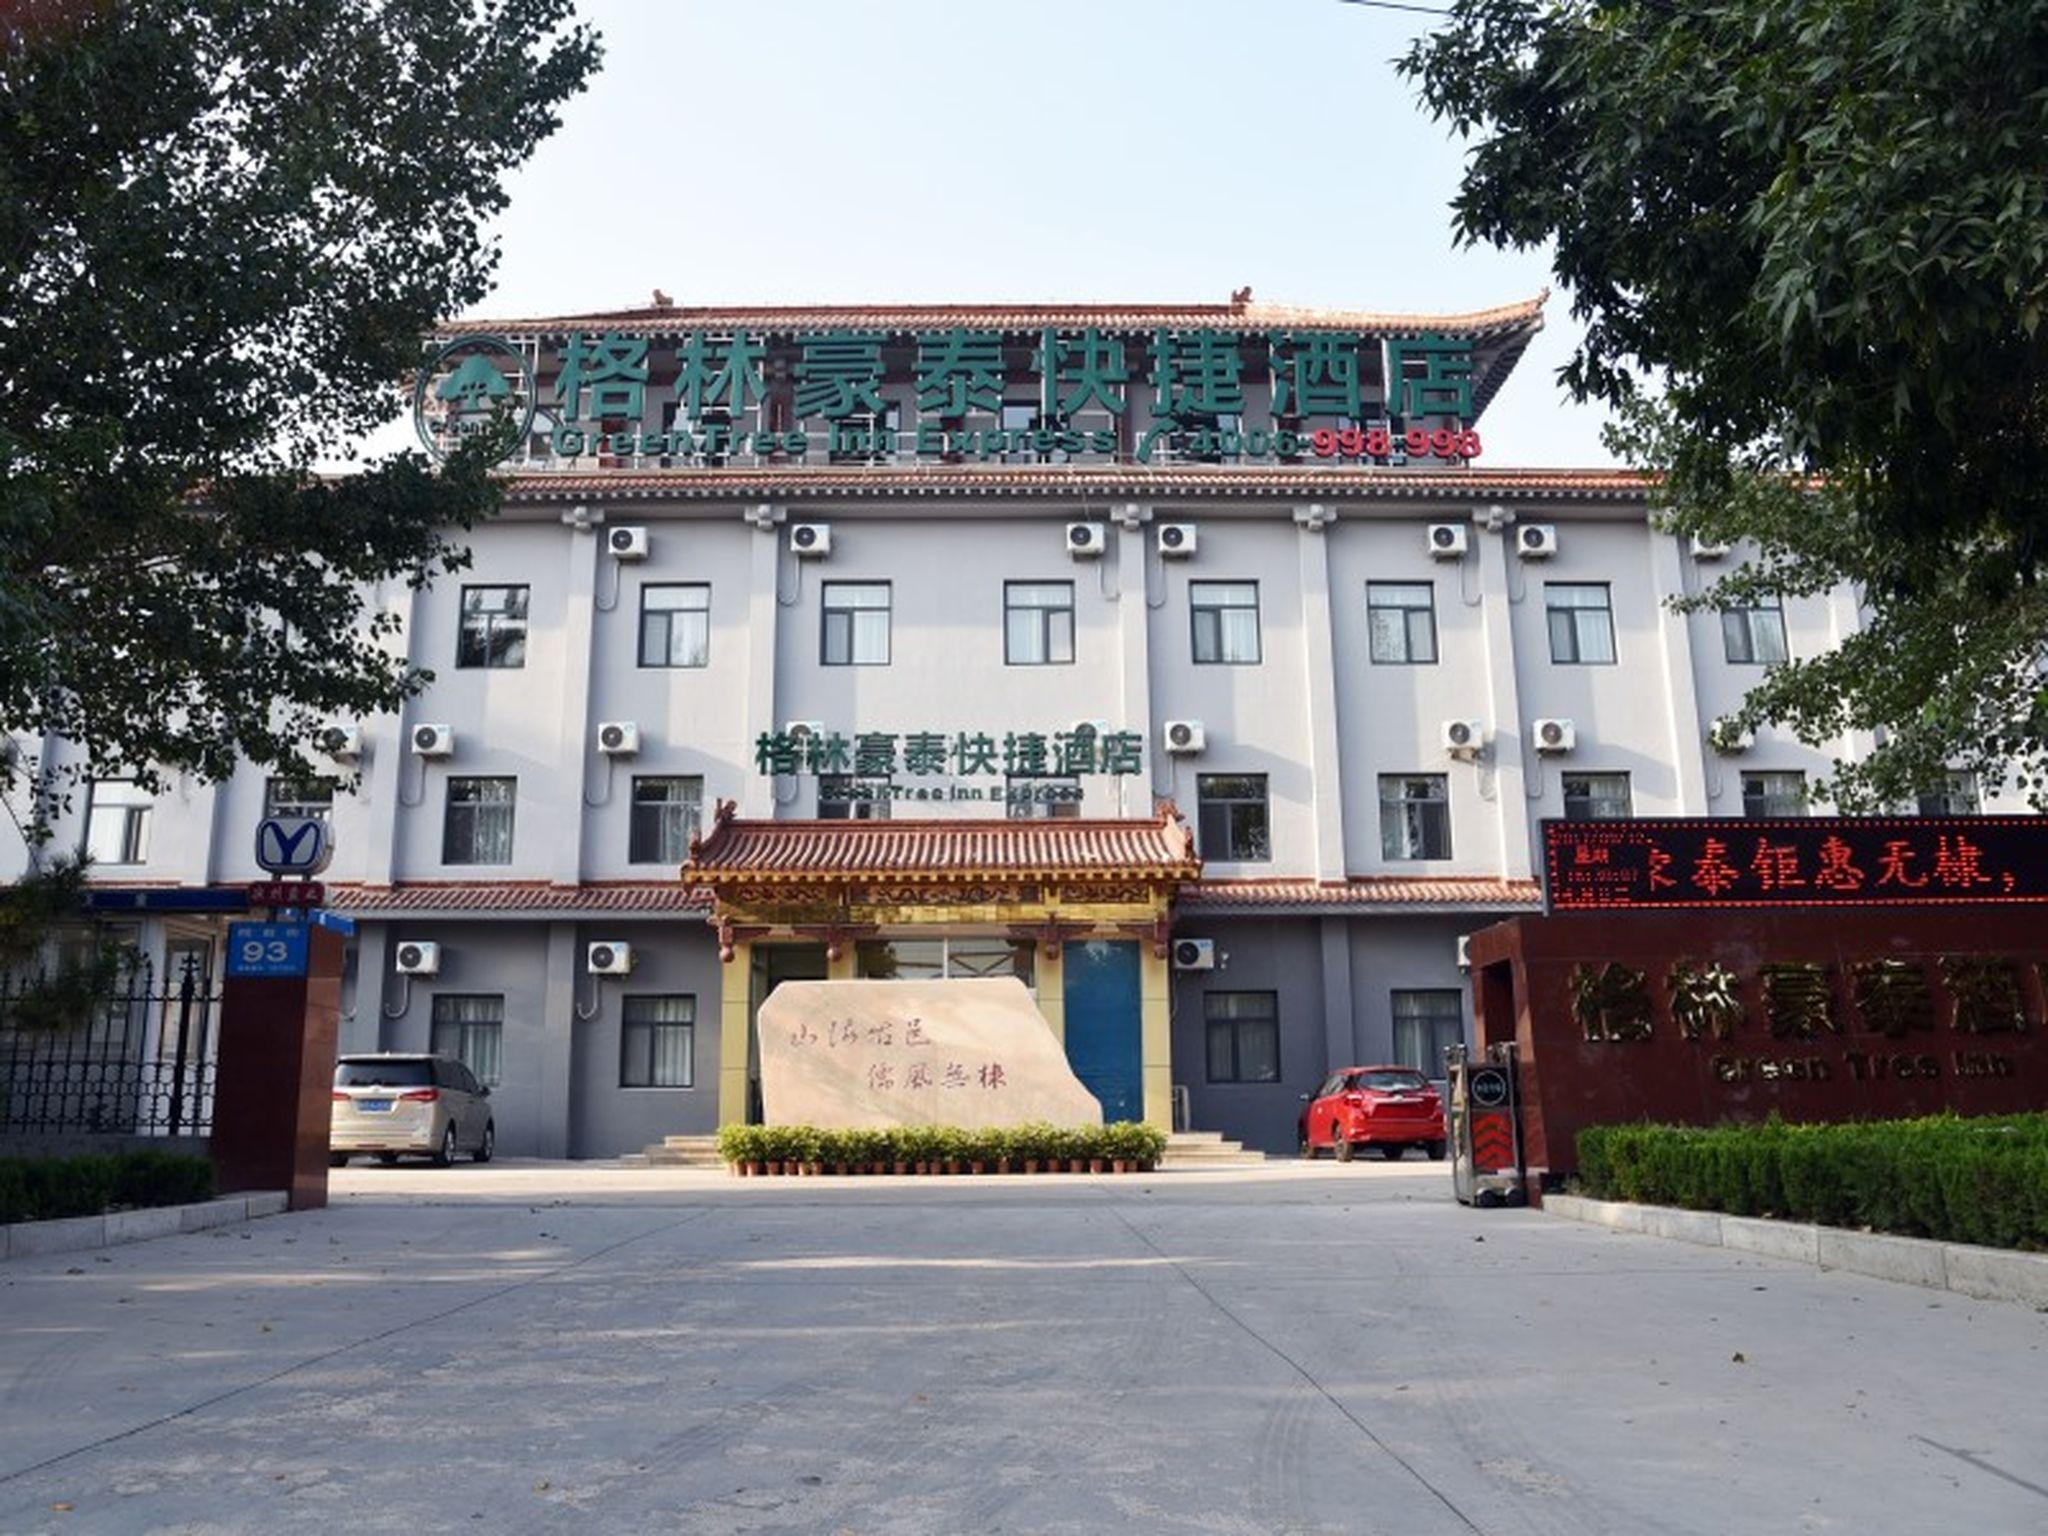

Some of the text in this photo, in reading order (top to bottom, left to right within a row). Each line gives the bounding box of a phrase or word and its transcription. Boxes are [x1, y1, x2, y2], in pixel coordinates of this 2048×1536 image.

[555, 330, 1475, 420] 格林豪泰快捷酒店
[827, 422, 897, 454] Inn
[916, 423, 1117, 463] Express
[755, 731, 1143, 777] 格林豪泰快捷酒店
[242, 940, 289, 963] 93
